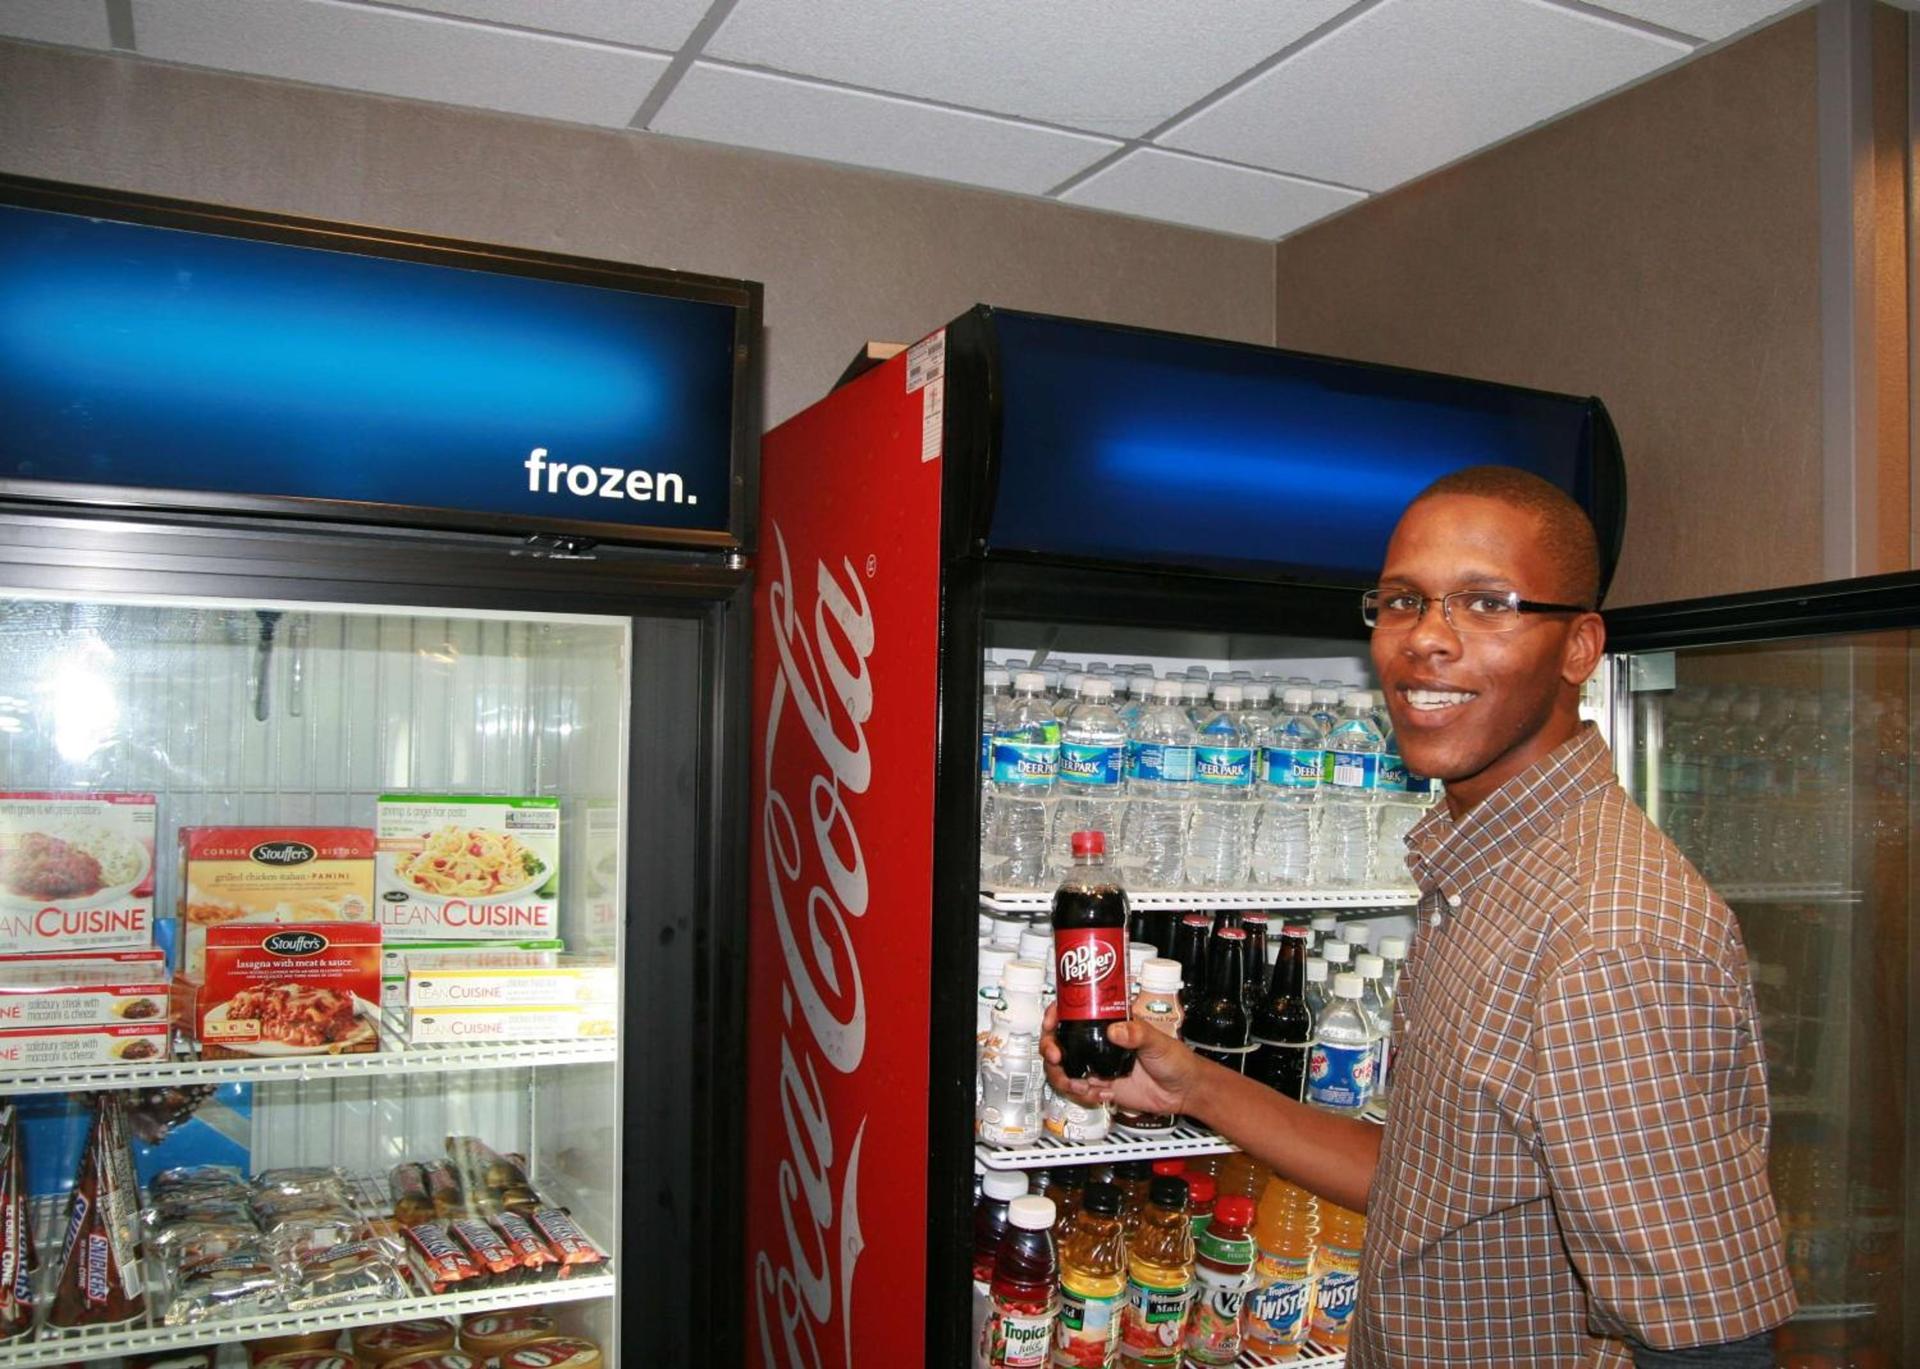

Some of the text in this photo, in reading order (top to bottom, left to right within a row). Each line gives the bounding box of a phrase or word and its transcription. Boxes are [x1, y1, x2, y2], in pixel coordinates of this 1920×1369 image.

[524, 448, 697, 505] frozen.
[1077, 760, 1100, 773] PARK
[1220, 763, 1244, 776] PARK
[258, 845, 309, 862] Stouffer's
[443, 899, 548, 927] CUISINE
[0, 914, 33, 938] AN
[271, 936, 321, 951] Stouffer's
[237, 959, 271, 969] lasagna
[273, 958, 294, 967] with
[296, 959, 318, 967] meat
[1076, 945, 1098, 965] Dr
[1060, 950, 1112, 982] Pepper
[2, 1250, 15, 1286] CONE
[90, 1237, 108, 1299] SNICKERS
[1155, 1301, 1183, 1314] Maid
[1003, 1319, 1052, 1342] Tropica
